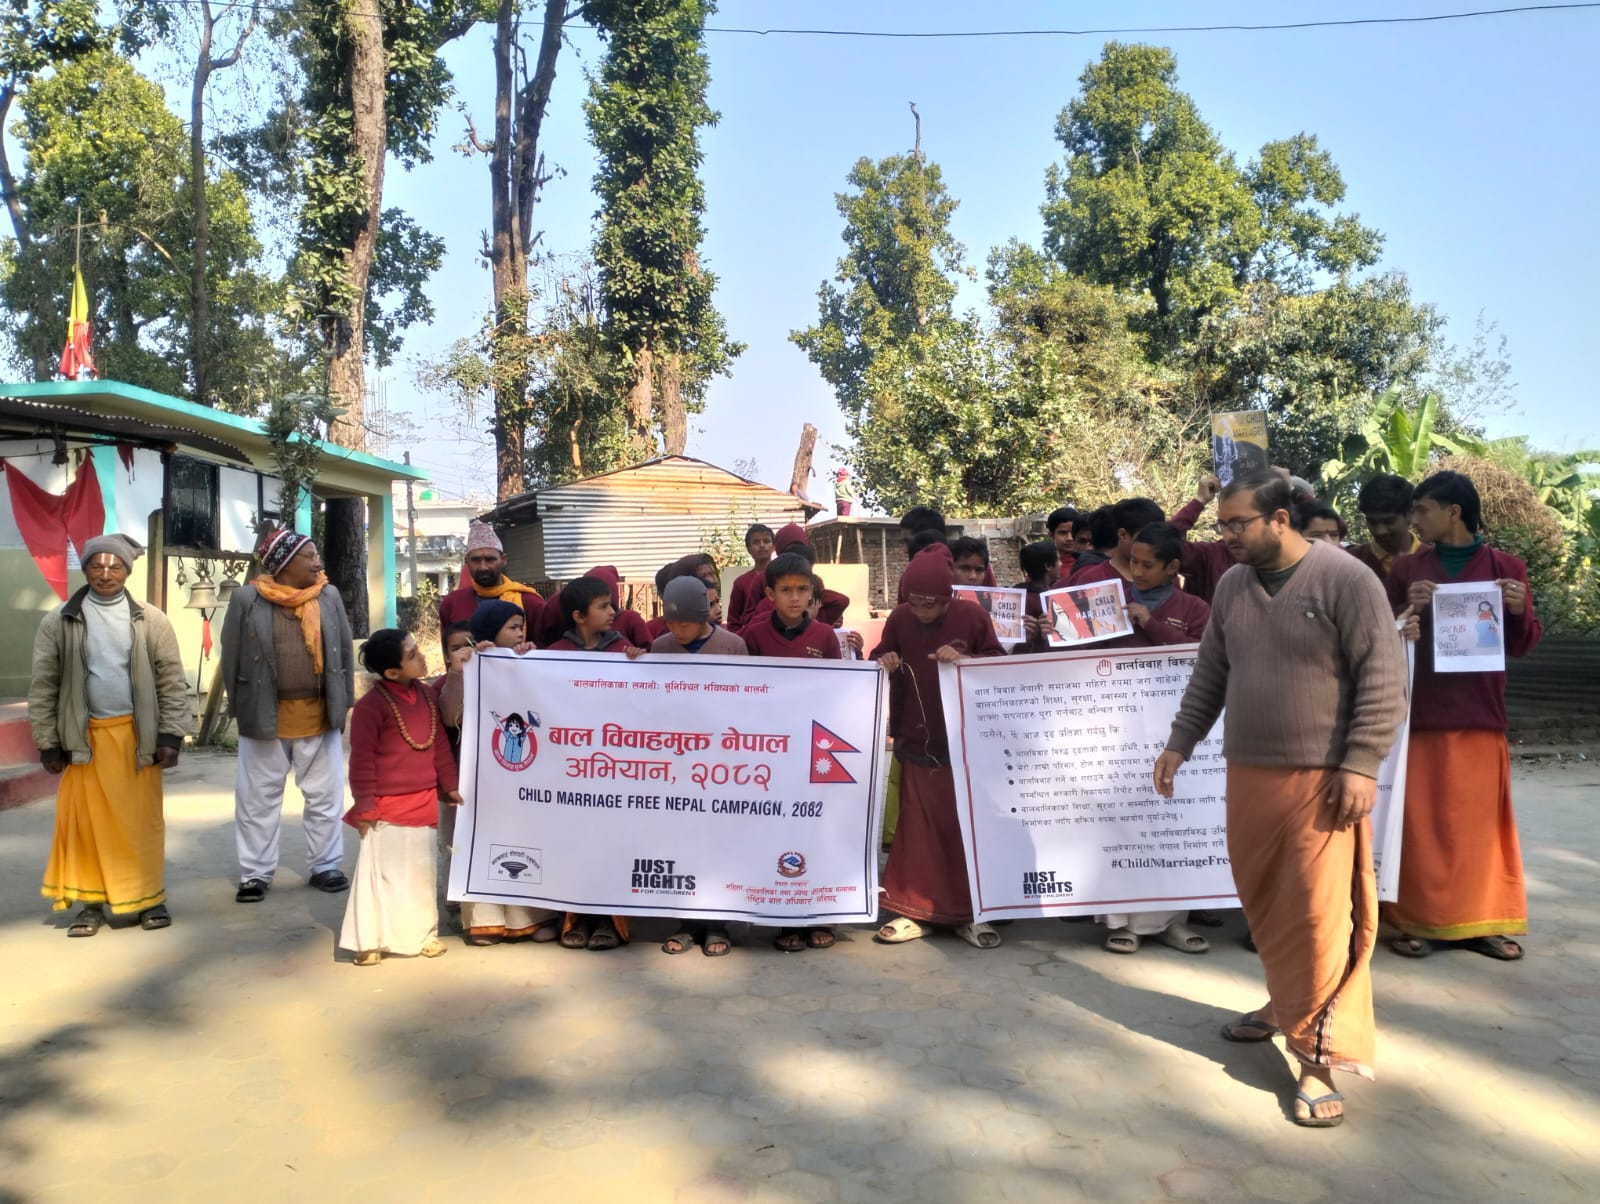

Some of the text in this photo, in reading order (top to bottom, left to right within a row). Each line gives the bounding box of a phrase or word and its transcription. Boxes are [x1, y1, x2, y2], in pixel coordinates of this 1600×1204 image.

[998, 601, 1016, 610] CHILD
[1095, 595, 1115, 606] CHILD
[990, 611, 1016, 620] RIAGE
[1075, 607, 1117, 620] MARRIAGE
[548, 723, 791, 756] बाल विवाहमुक्त नेपाल
[566, 752, 676, 784] अभियान,
[691, 762, 772, 791] २०८२
[518, 787, 824, 818] CHILD MARRIAGE FREE NEPAL CAMPAIGN, 2082
[632, 858, 676, 874] JUST
[1112, 855, 1231, 869] #ChildMarriageFre
[632, 873, 696, 890] RIGHTS
[1023, 870, 1056, 883] JUST
[1023, 881, 1073, 894] RIGHTS
